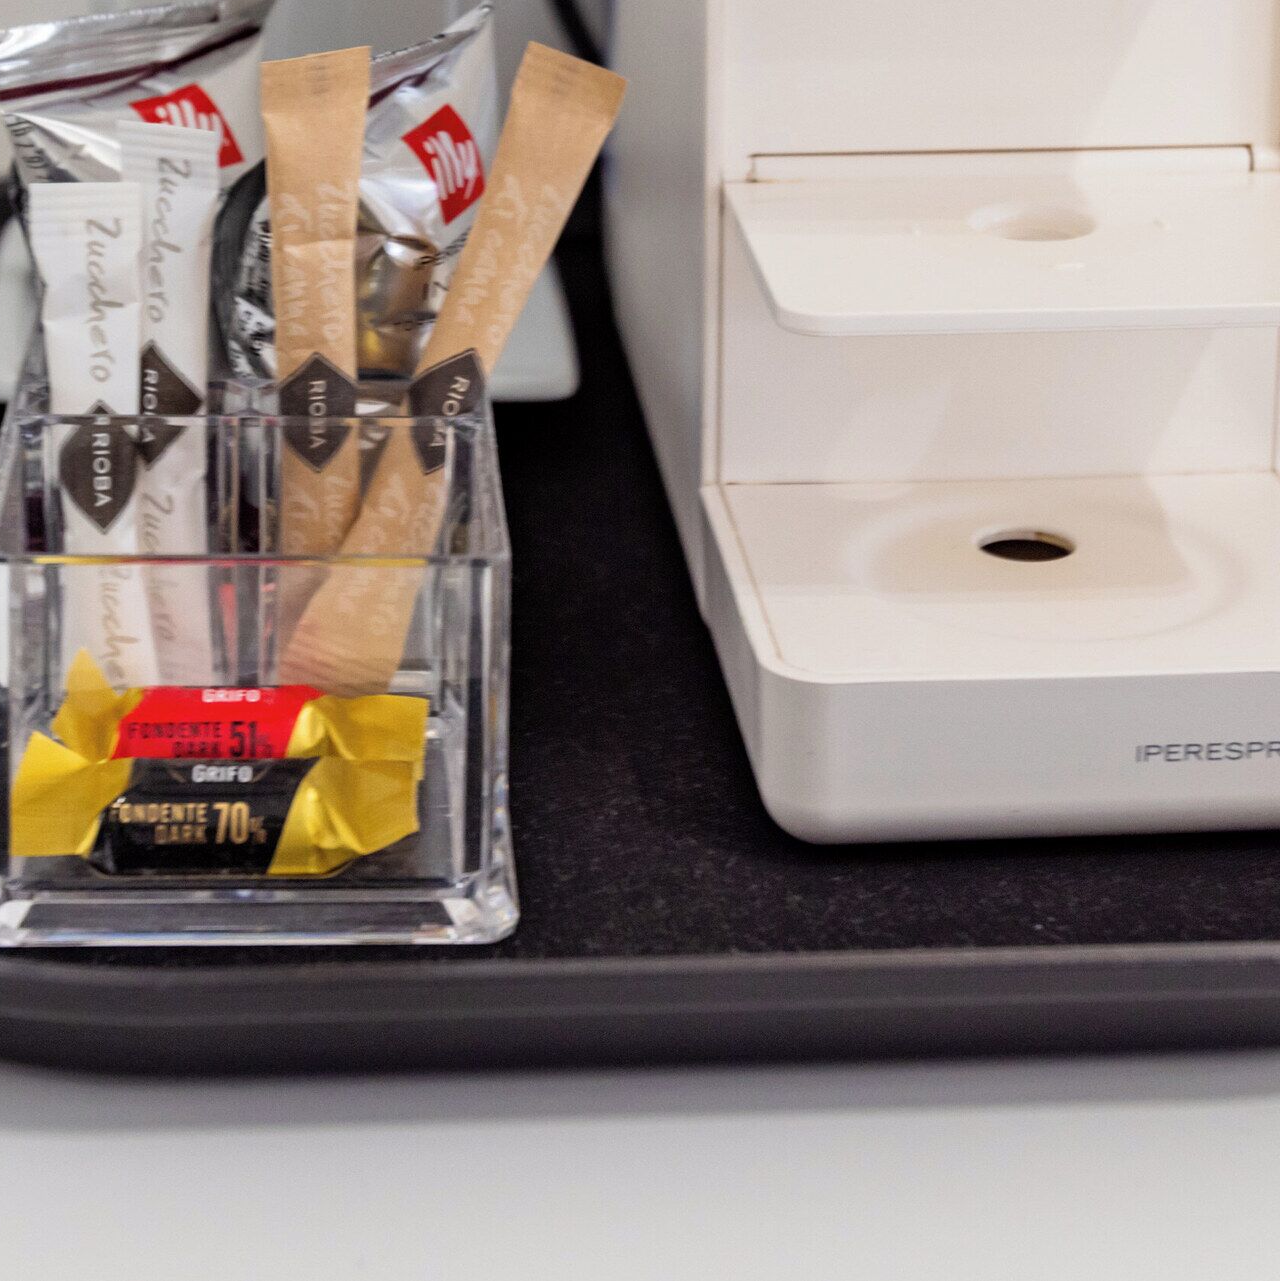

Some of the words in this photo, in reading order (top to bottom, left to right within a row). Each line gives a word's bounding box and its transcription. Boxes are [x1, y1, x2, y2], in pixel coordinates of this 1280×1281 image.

[422, 130, 477, 200] illy
[147, 157, 192, 323] Zucchero
[86, 217, 125, 382] Zucchero
[141, 369, 160, 443] RIOA
[91, 432, 113, 508] RIOBA
[201, 688, 262, 703] GRIFO
[127, 721, 223, 739] FONDENTE
[173, 740, 220, 758] DARK
[191, 763, 254, 784] GRIFO
[111, 801, 209, 824] FONDENTE
[211, 800, 268, 845] 70%
[153, 823, 208, 845] DARK
